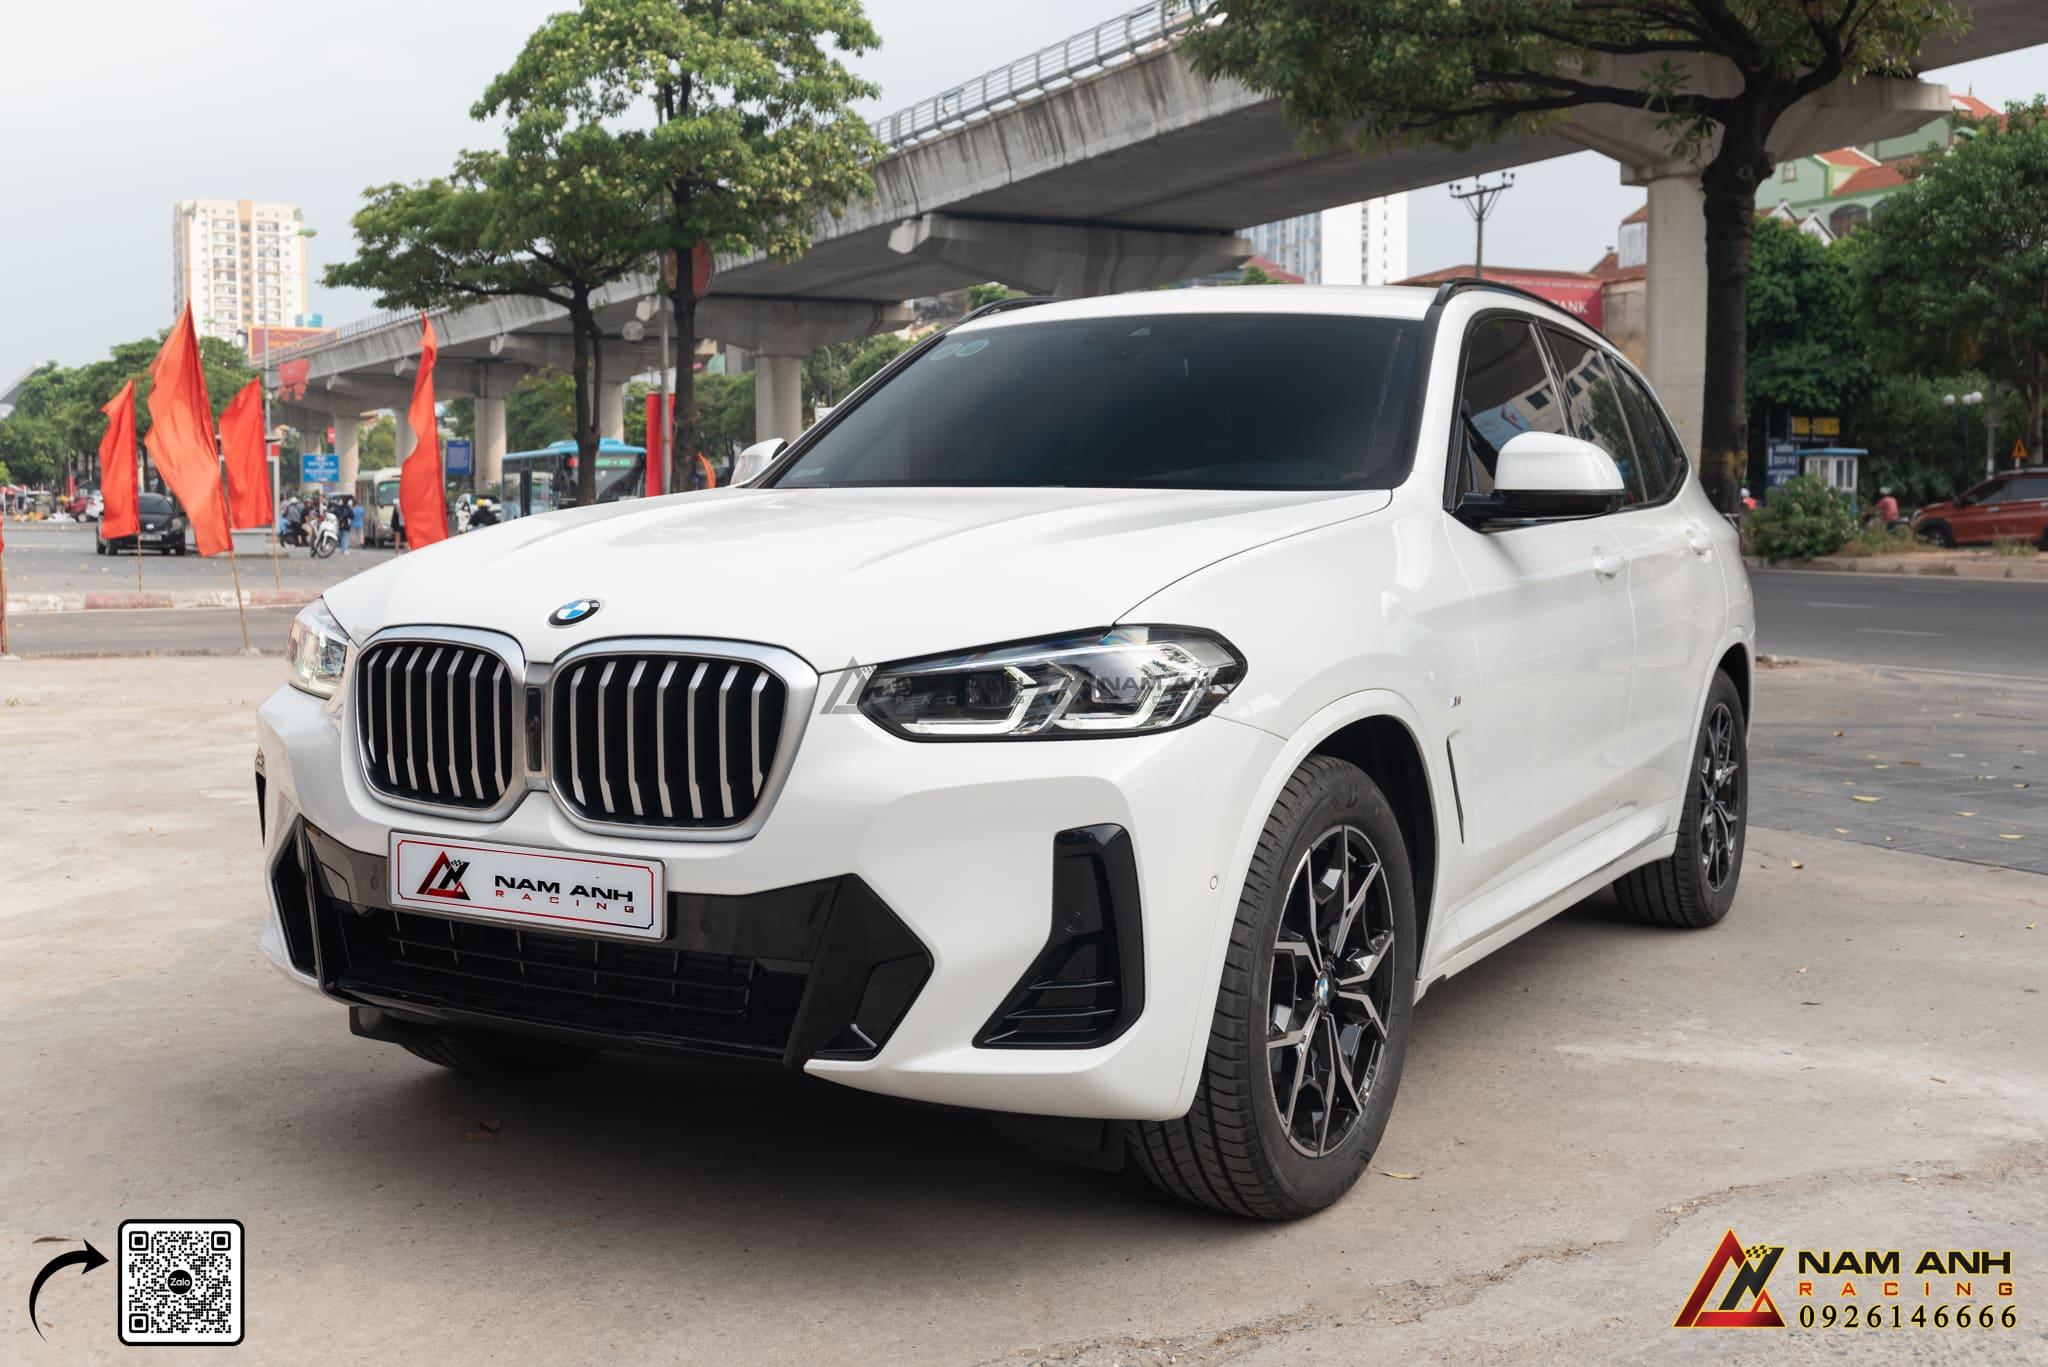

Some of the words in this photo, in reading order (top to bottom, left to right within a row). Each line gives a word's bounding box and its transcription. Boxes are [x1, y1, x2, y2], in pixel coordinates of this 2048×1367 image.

[494, 875, 560, 894] NAM
[569, 885, 633, 902] ANH
[496, 889, 635, 914] RACING
